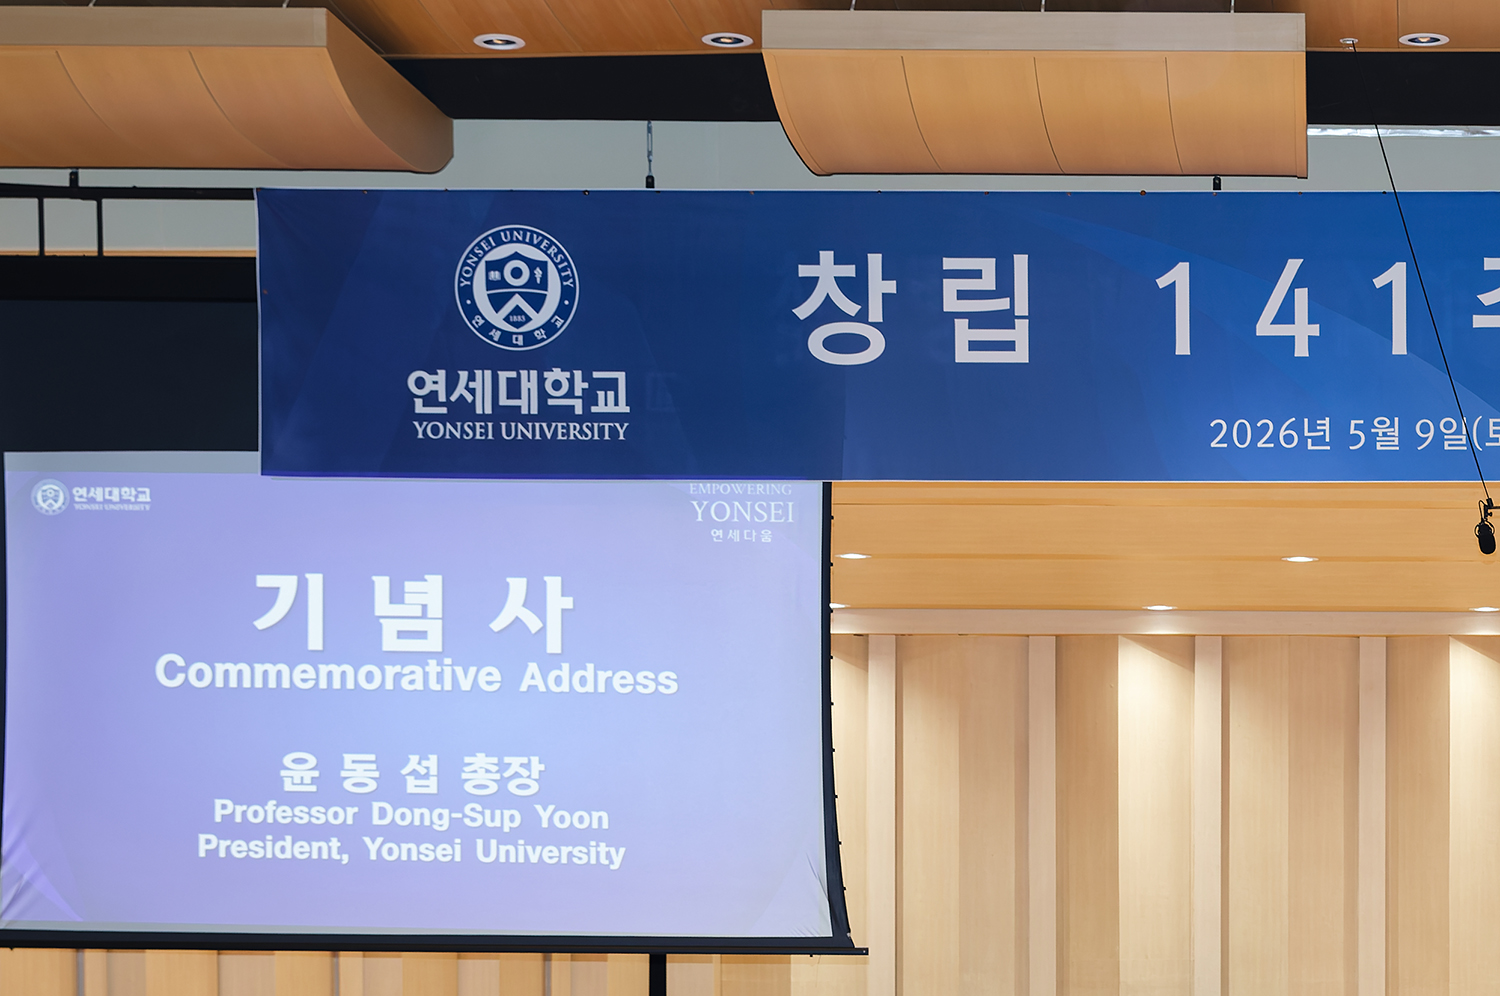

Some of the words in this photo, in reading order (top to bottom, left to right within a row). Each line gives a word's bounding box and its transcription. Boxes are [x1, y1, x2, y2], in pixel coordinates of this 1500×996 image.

[460, 236, 496, 288] YONSEI
[500, 230, 574, 288] UNIVERSITY
[791, 250, 1030, 366] 창립
[407, 367, 631, 415] 연세대학교
[412, 420, 495, 441] YONSEI
[499, 421, 629, 442] UNIVERSITY
[1209, 416, 1331, 450] 2026년
[1348, 416, 1400, 451] 5월
[72, 486, 151, 502] 연세대학교
[689, 482, 792, 496] EMPOWERING
[690, 500, 794, 523] YONSEI
[711, 529, 772, 542] 연세다움
[155, 654, 502, 692] Commemorative
[519, 662, 679, 695] Address
[461, 752, 546, 796] 총장
[213, 799, 359, 826] Professor
[371, 801, 522, 833] Dong-Sup
[533, 804, 609, 830] Yoon
[198, 833, 349, 864] President,
[362, 836, 462, 863] Yonsei
[476, 838, 626, 870] University
